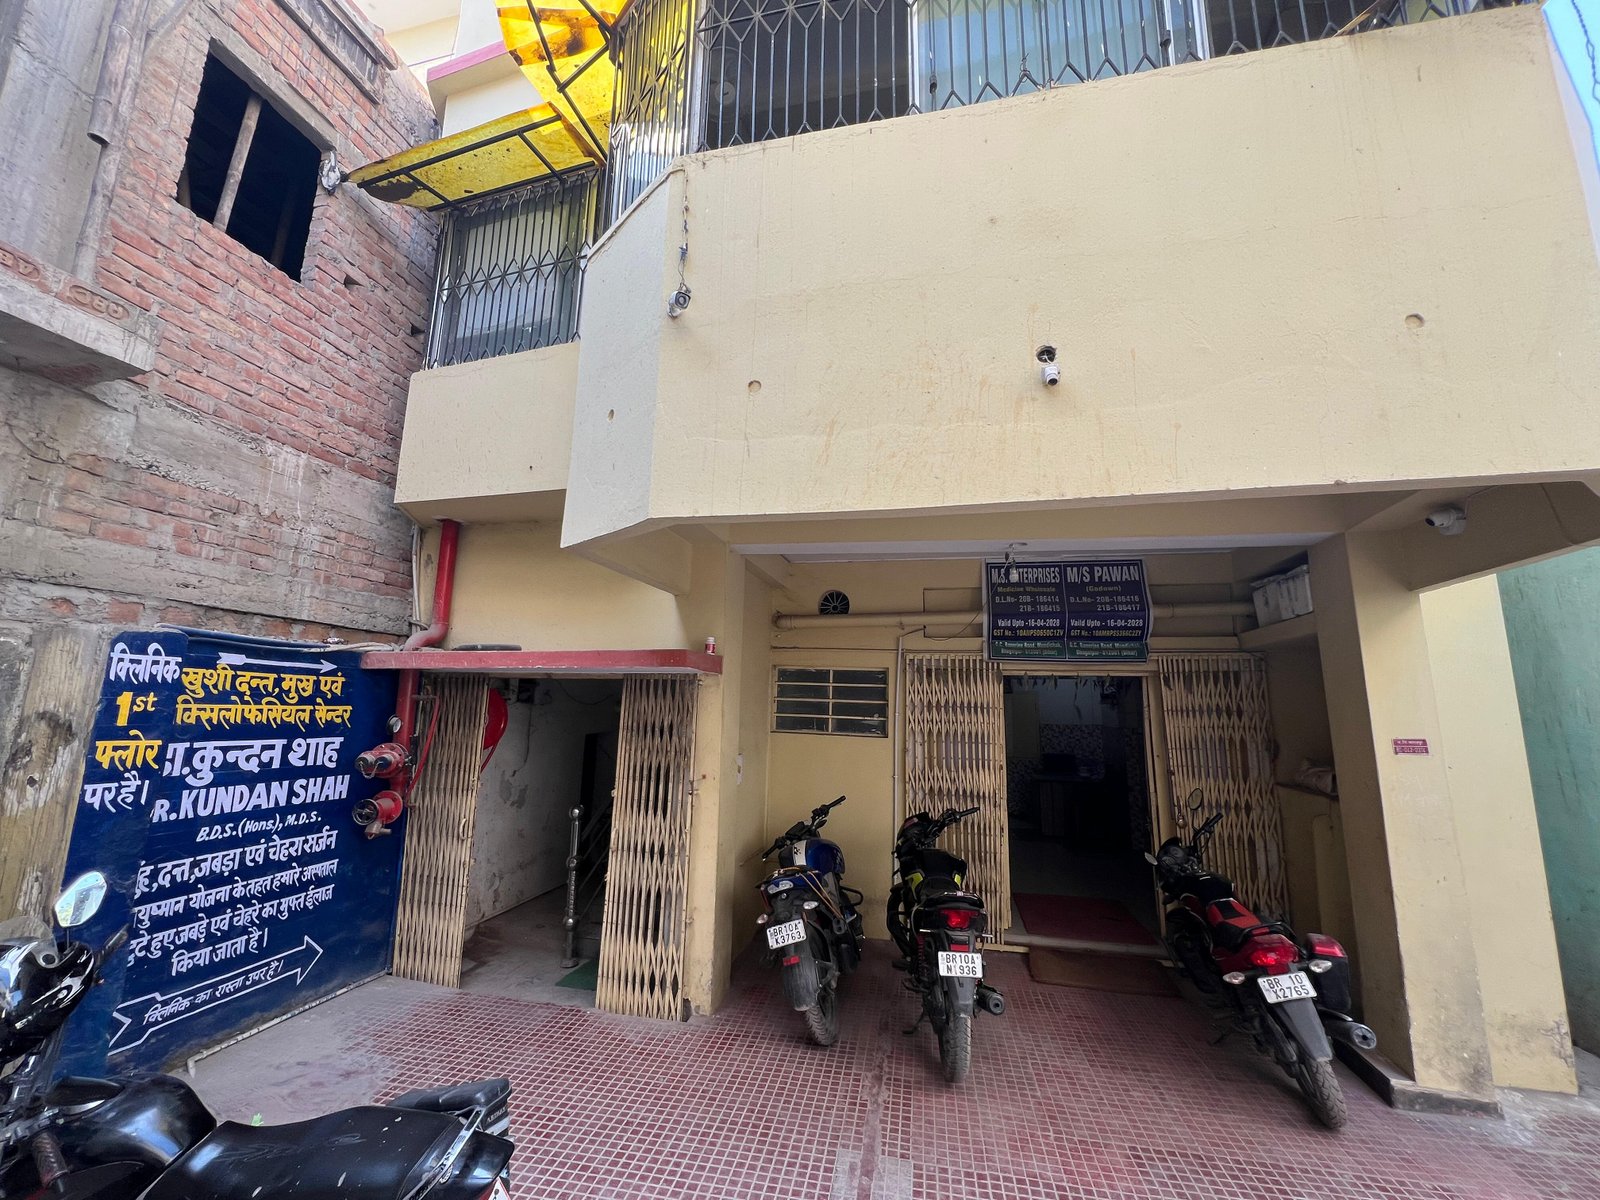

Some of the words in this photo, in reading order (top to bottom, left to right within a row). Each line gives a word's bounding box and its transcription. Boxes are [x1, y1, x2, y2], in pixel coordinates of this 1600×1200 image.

[1067, 566, 1090, 584] M/S
[1095, 565, 1139, 582] PAWAN
[110, 642, 182, 684] क्लिनिक
[181, 663, 235, 698] खुशी
[280, 673, 317, 704] मुख
[319, 671, 346, 699] एवं
[116, 691, 158, 726] 1st
[314, 697, 353, 728] सेन्टर
[95, 729, 163, 771] फ्लोर
[288, 736, 344, 769] शाह
[290, 774, 351, 806] SHAH
[284, 811, 322, 827] M.D.S.
[244, 838, 267, 867] एवं
[268, 834, 305, 862] चेहरा
[303, 825, 338, 853] सर्जन
[189, 884, 232, 909] योजना
[232, 876, 247, 898] के
[246, 875, 274, 897] तहत
[272, 862, 302, 892] हमारे
[301, 859, 339, 881] अस्पताल
[210, 908, 233, 936] एवं
[233, 900, 262, 926] चेहरे
[261, 900, 280, 918] का
[277, 892, 306, 920] मुफ्त
[305, 884, 335, 910] ईलाज
[773, 923, 800, 937] BR10A
[775, 931, 802, 946] K3763
[171, 947, 213, 976] किया
[213, 935, 248, 963] जाता
[945, 953, 976, 965] BR10A
[143, 997, 194, 1025] क्लिनिक
[195, 989, 213, 1003] का
[215, 976, 246, 998] रास्ता
[246, 967, 270, 985] उपर
[1266, 977, 1283, 990] BR
[1289, 974, 1304, 986] 10
[1272, 984, 1310, 999] X2765
